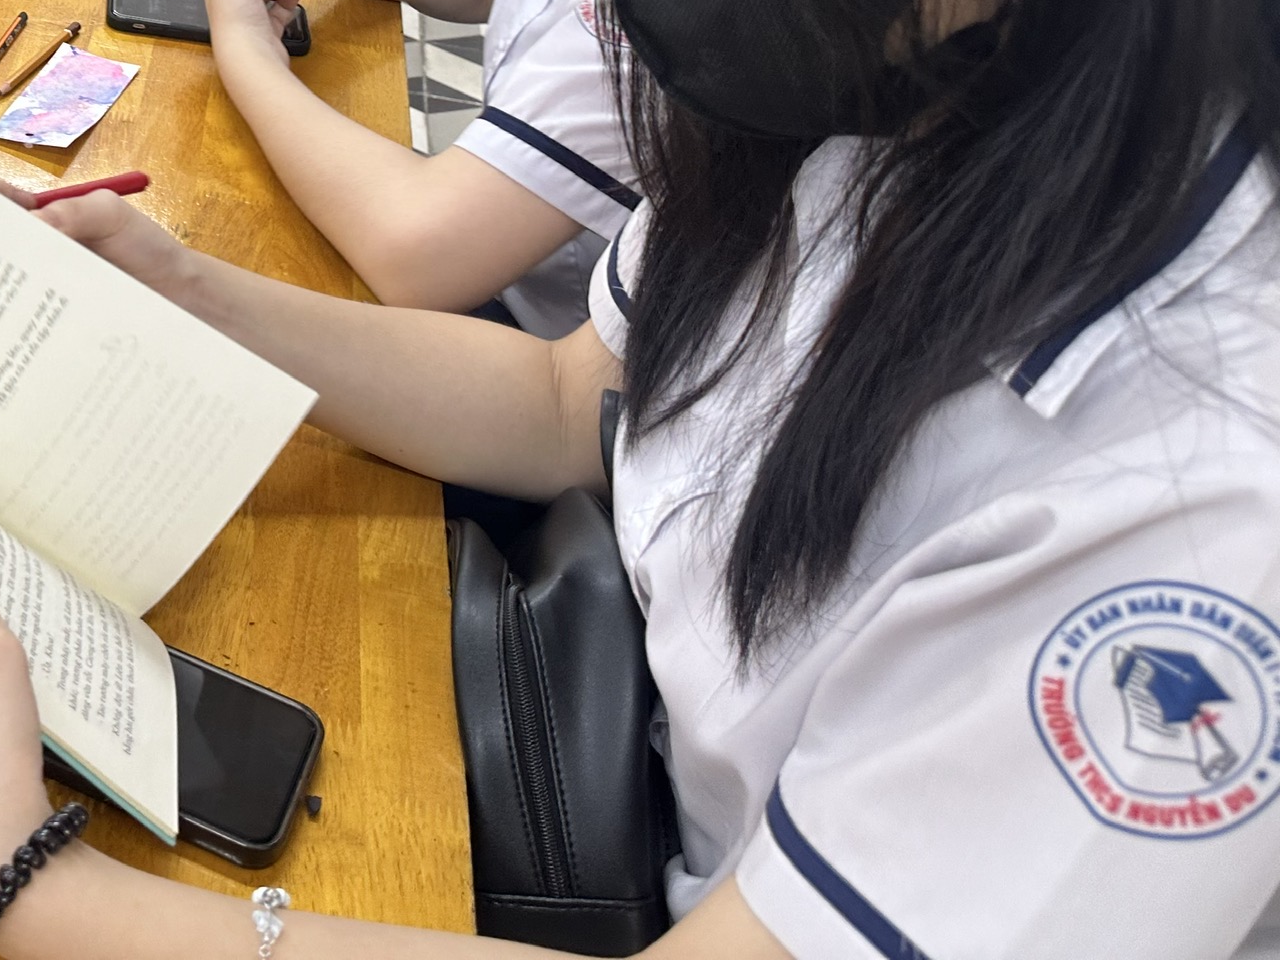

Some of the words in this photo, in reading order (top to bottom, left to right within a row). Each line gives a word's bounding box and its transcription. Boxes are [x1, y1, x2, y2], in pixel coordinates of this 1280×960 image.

[1086, 597, 1124, 632] BAN
[1125, 592, 1184, 617] NHÂN
[1188, 599, 1233, 631] DÂN
[1041, 675, 1086, 762] TRƯỜNG
[1077, 761, 1125, 816] THCS
[1125, 793, 1223, 828] NGUYỄN
[1222, 783, 1258, 816] DU
